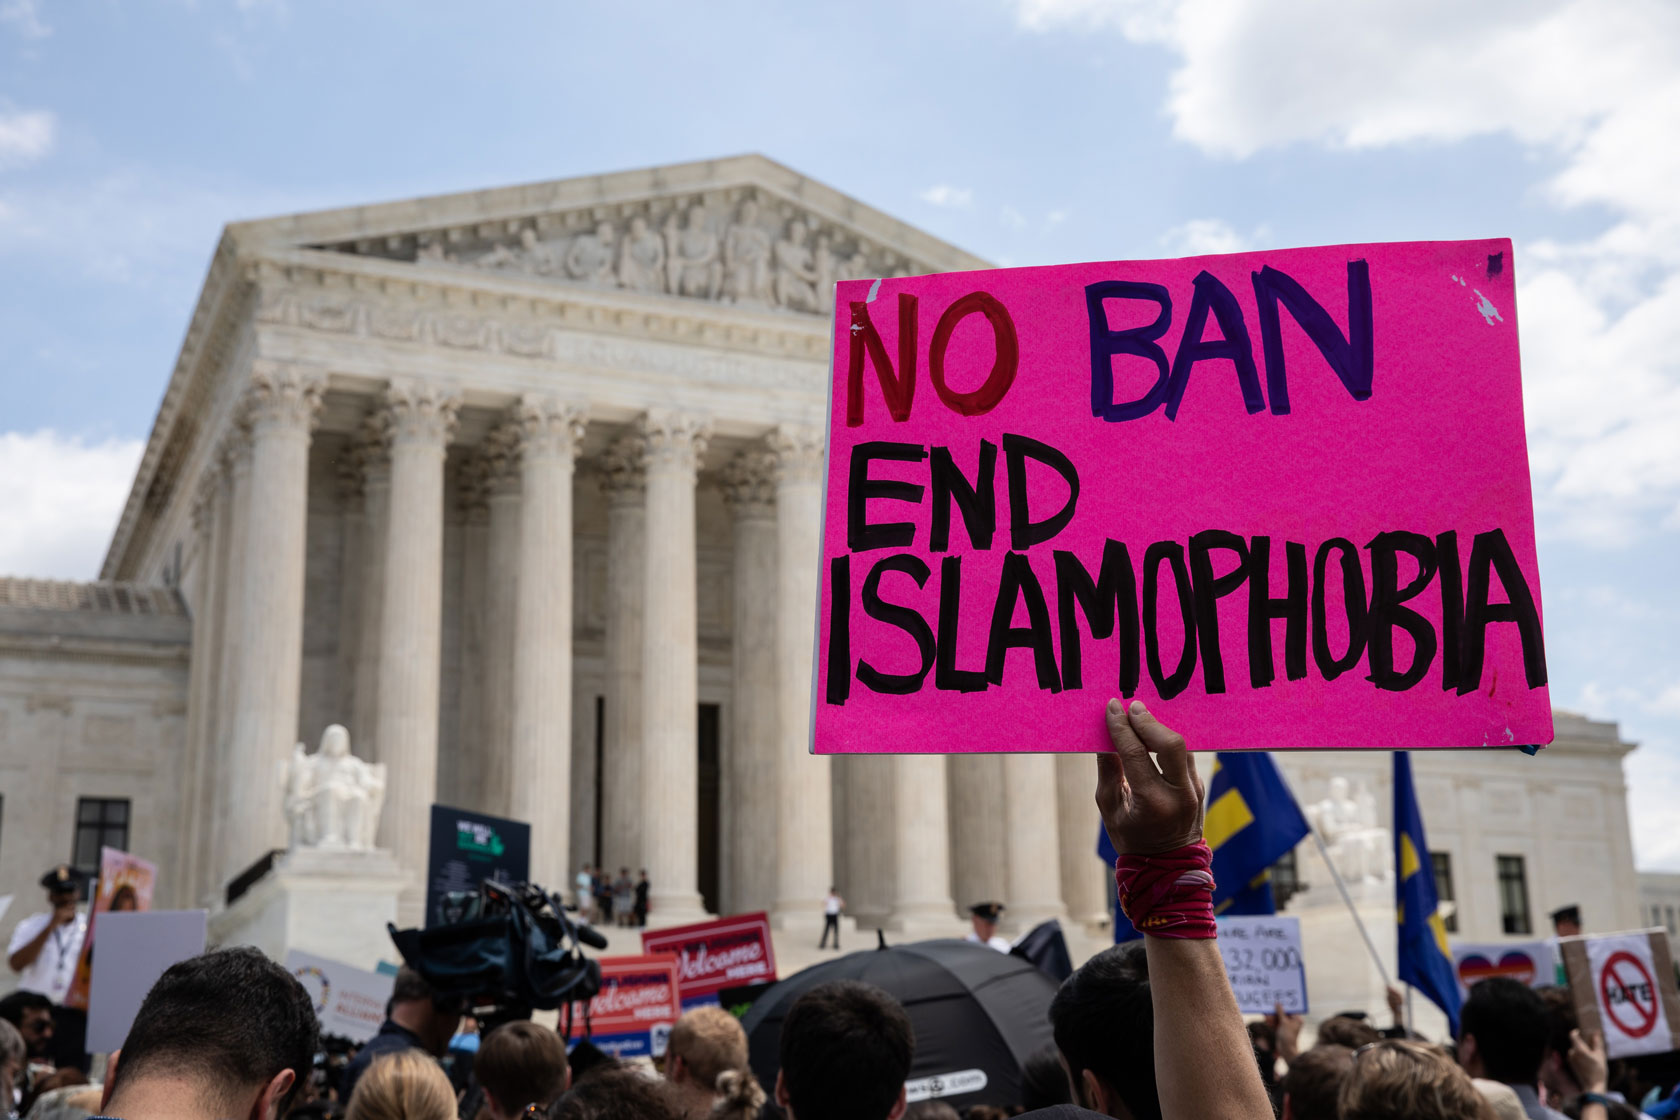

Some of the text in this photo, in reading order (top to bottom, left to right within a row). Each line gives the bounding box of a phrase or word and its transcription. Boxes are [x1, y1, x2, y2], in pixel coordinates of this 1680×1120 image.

[847, 291, 1019, 427] NO
[1085, 258, 1374, 423] BAN
[847, 433, 1080, 552] END
[827, 527, 1547, 706] ISLAMOPHOBIA
[633, 1004, 671, 1021] HERE
[725, 960, 767, 980] HERE
